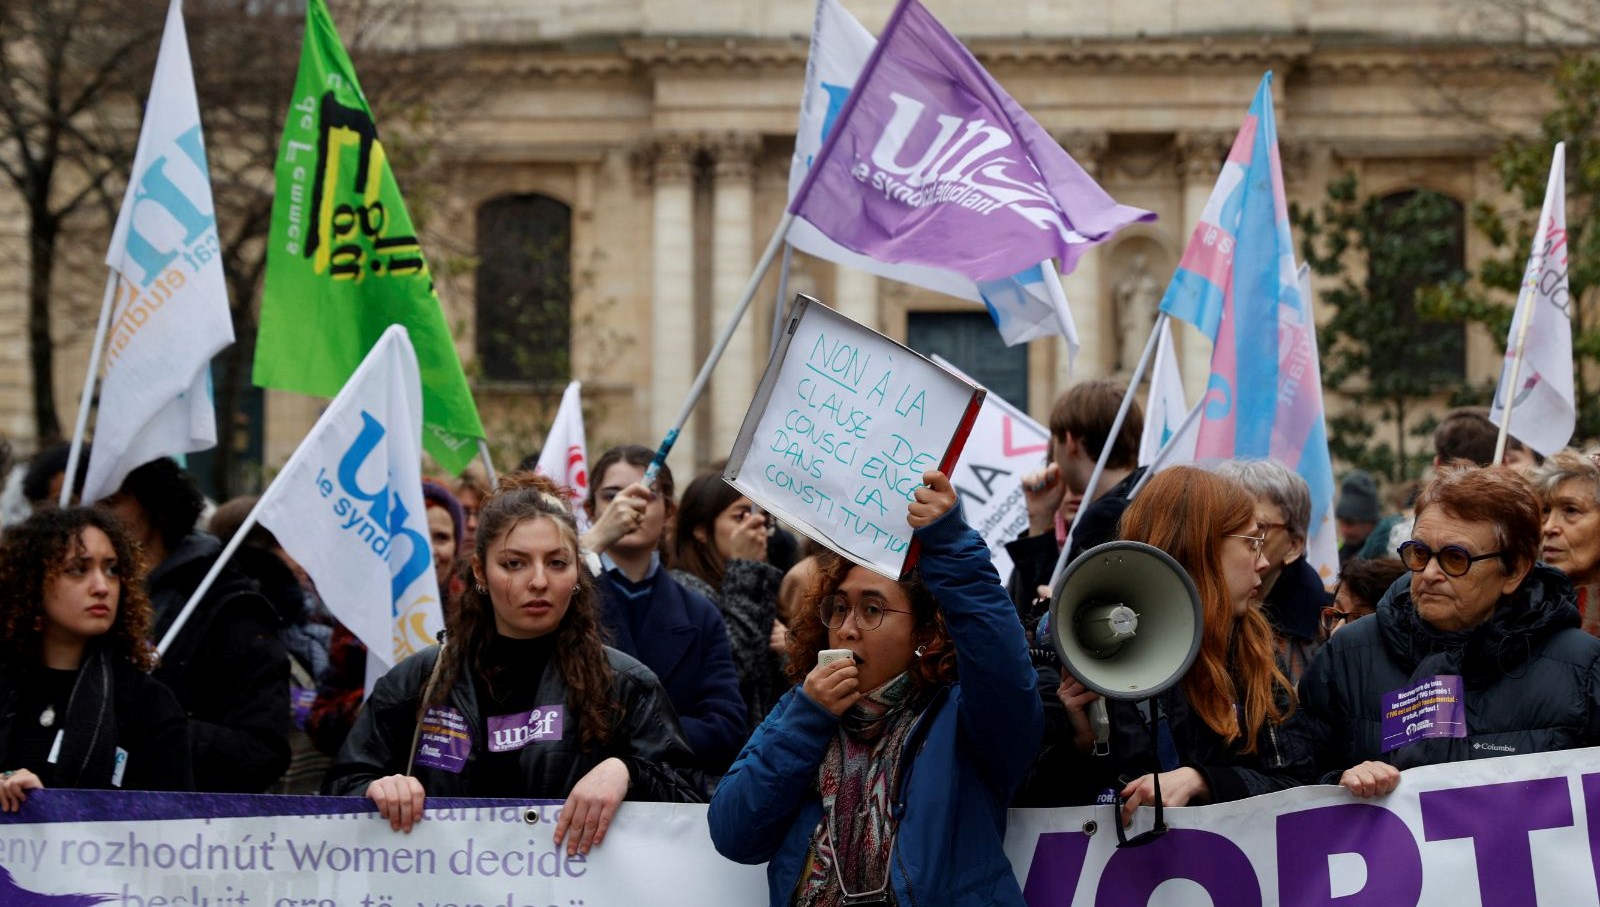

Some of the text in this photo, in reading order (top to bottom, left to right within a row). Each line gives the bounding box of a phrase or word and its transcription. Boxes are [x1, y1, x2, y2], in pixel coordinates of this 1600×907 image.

[809, 333, 871, 388] NON
[894, 383, 926, 427] LA
[797, 378, 936, 474] CLAUSE DE
[315, 467, 333, 498] le
[769, 429, 888, 516] DANS LA
[1481, 742, 1516, 753] Columbia
[286, 840, 436, 874] Women
[450, 838, 588, 878] decide
